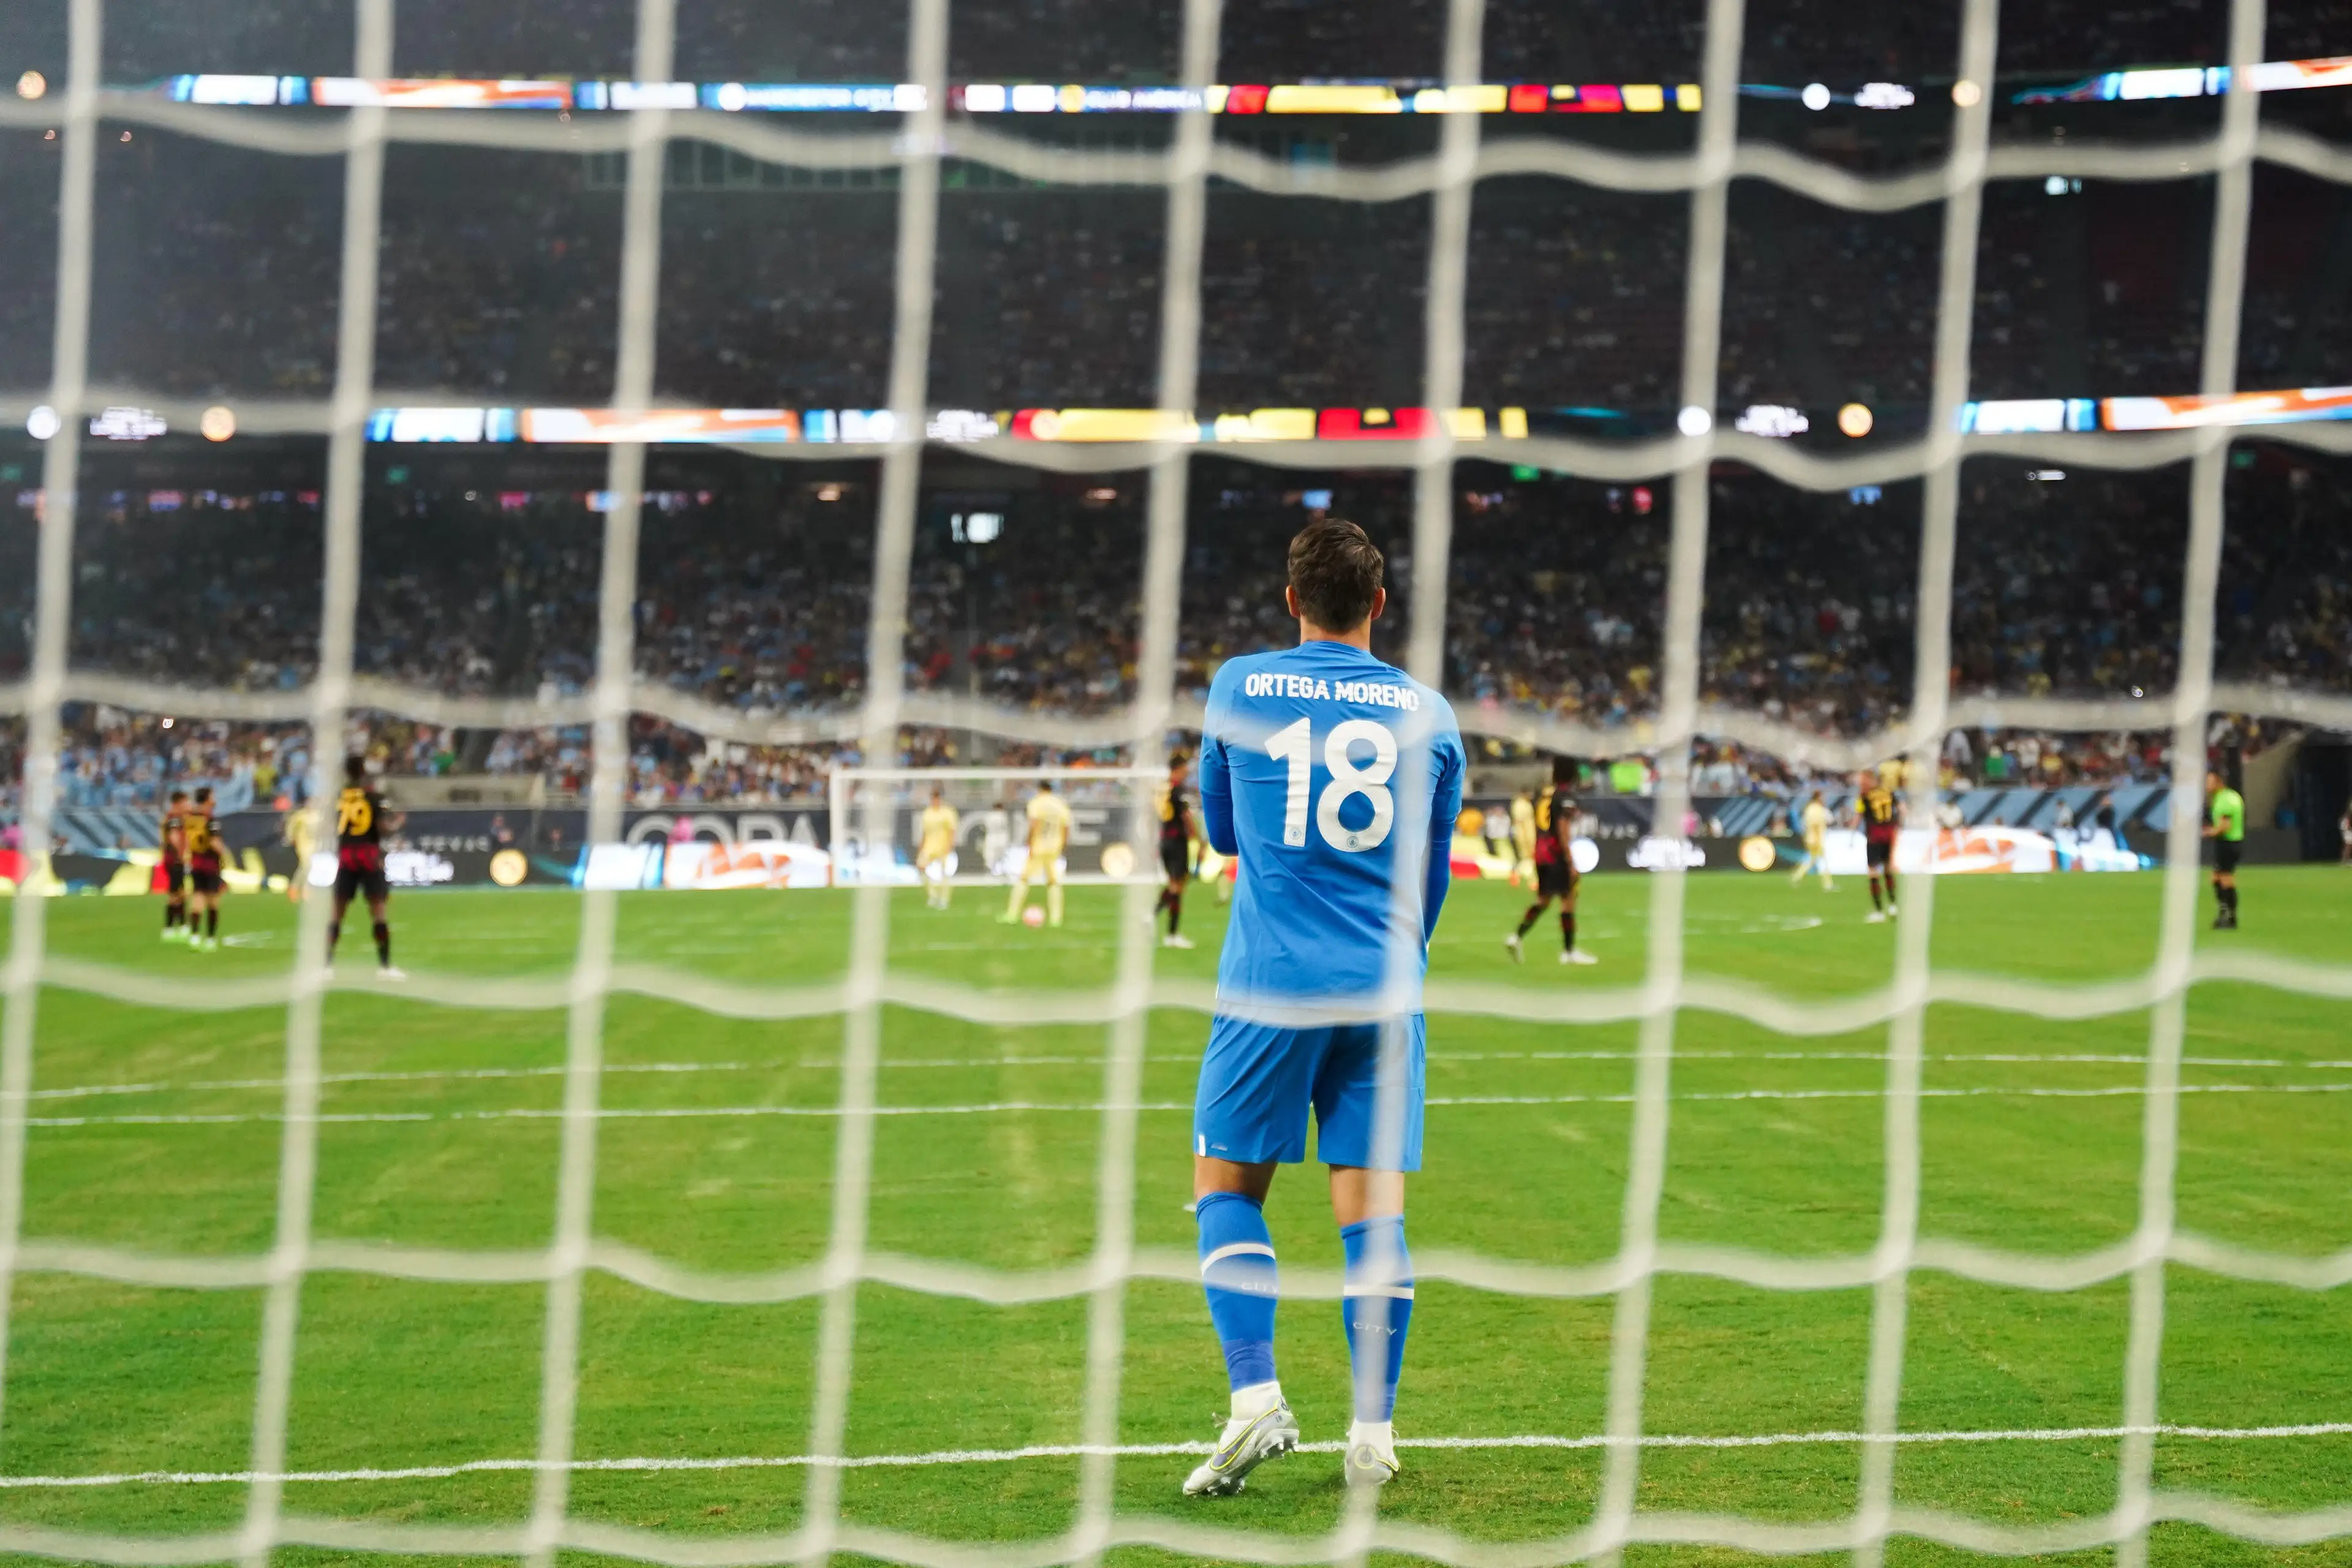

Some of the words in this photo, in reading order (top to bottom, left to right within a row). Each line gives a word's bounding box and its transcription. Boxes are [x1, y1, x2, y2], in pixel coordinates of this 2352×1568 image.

[1245, 673, 1330, 700] ORTEGA
[1335, 681, 1419, 711] MORENO
[1264, 717, 1397, 852] 18
[1352, 1321, 1397, 1336] CITY
